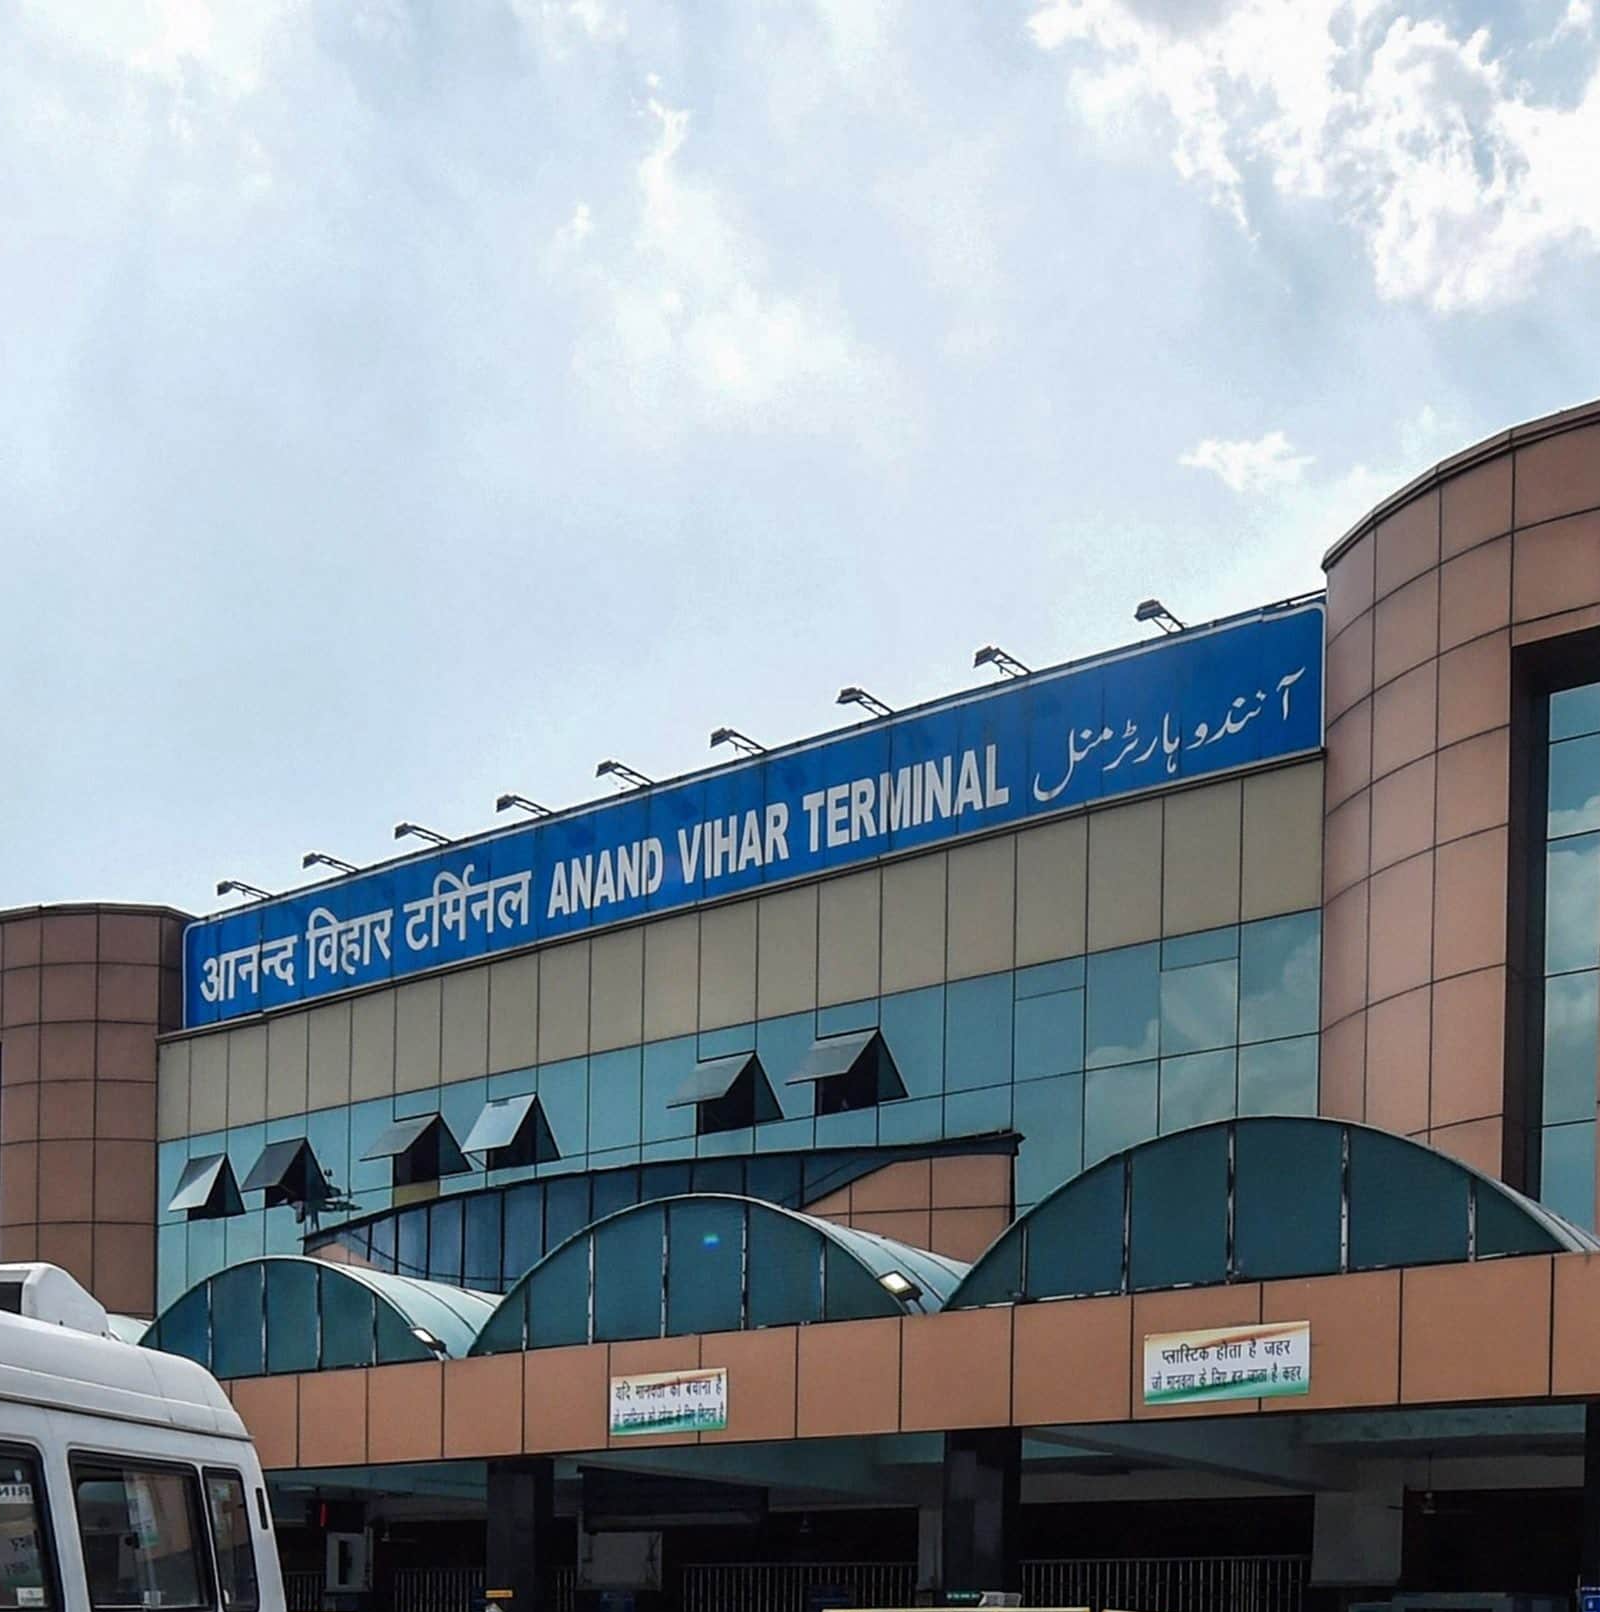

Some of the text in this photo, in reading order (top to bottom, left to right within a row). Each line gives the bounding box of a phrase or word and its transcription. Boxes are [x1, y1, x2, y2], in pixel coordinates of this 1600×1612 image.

[547, 744, 1010, 919] ANAND VIHAR TERMINAL
[200, 864, 532, 1002] आनन्द विहार टर्मिनल
[1162, 1338, 1291, 1364] प्लास्टिक होता है जहर
